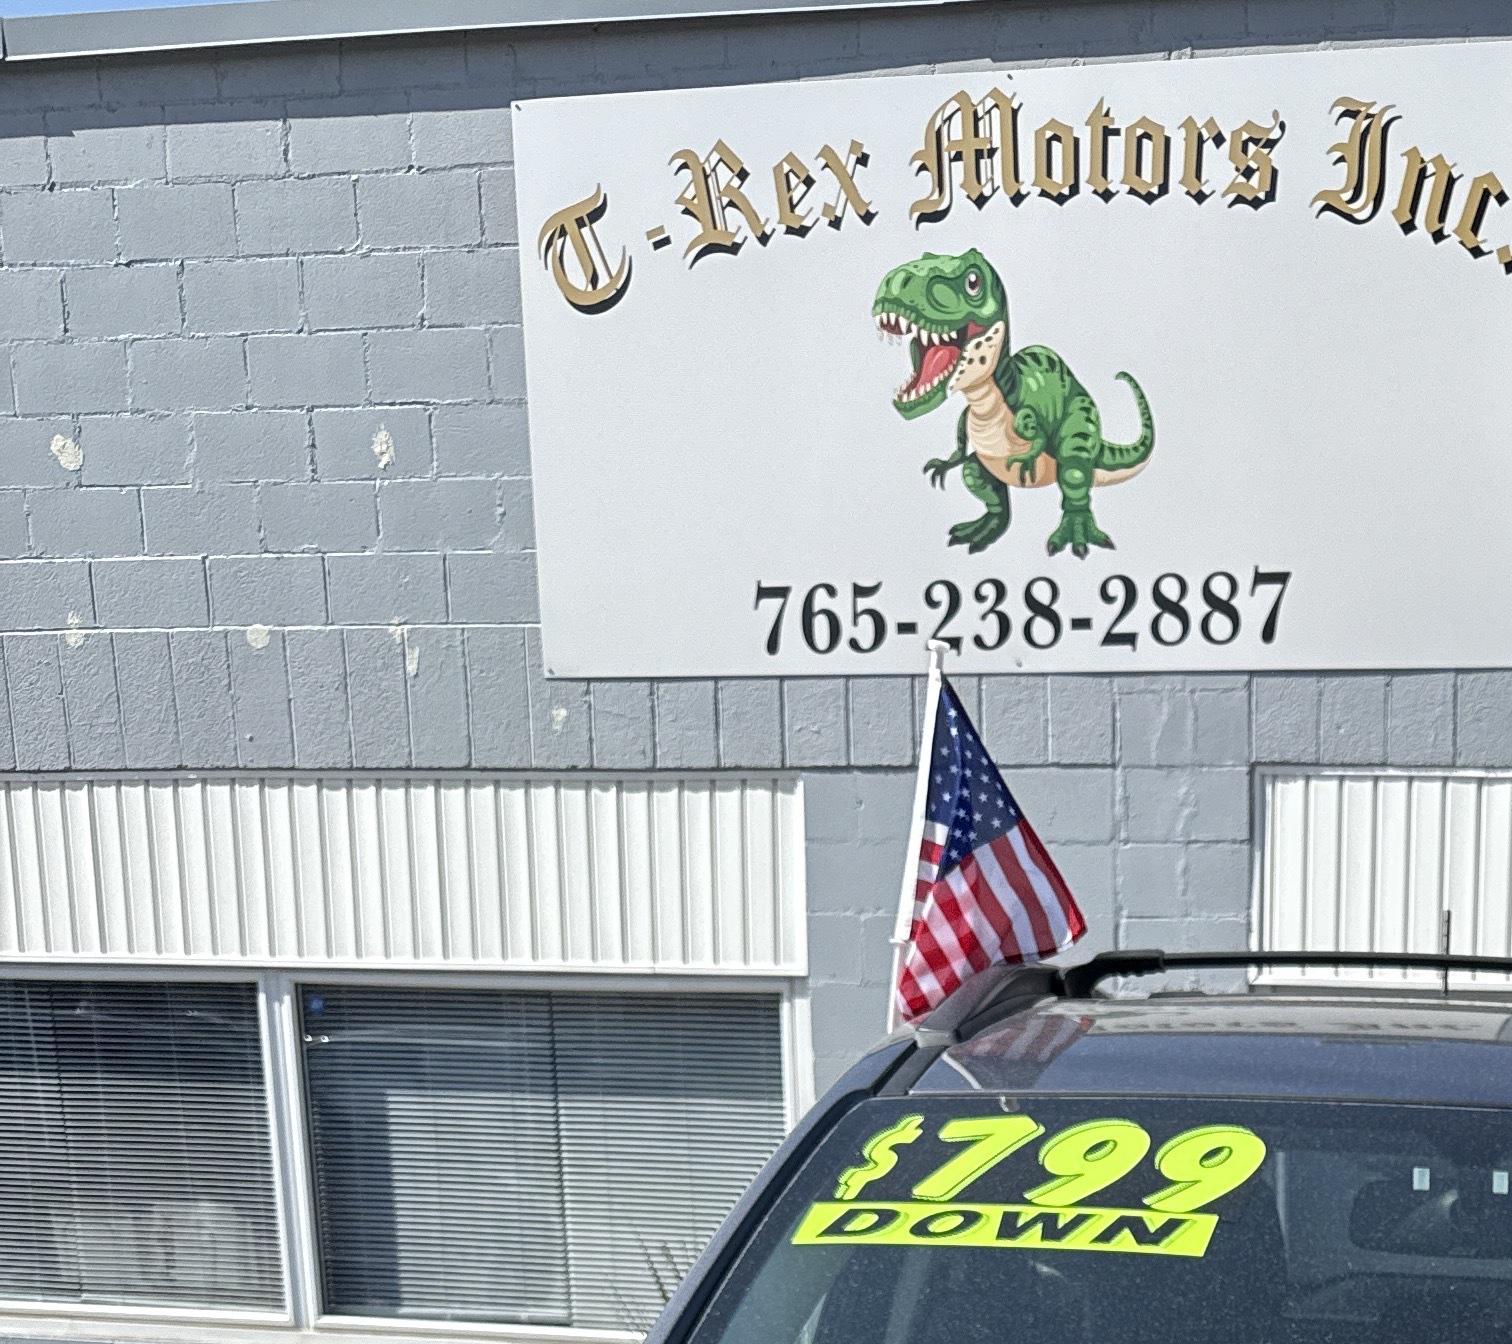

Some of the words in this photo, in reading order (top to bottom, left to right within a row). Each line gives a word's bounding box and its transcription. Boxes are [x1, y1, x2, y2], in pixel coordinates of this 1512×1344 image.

[910, 86, 1287, 232] Motors
[753, 566, 1293, 657] 765-238-2887
[834, 1113, 1267, 1213] $799
[816, 1208, 1190, 1248] DOWN
